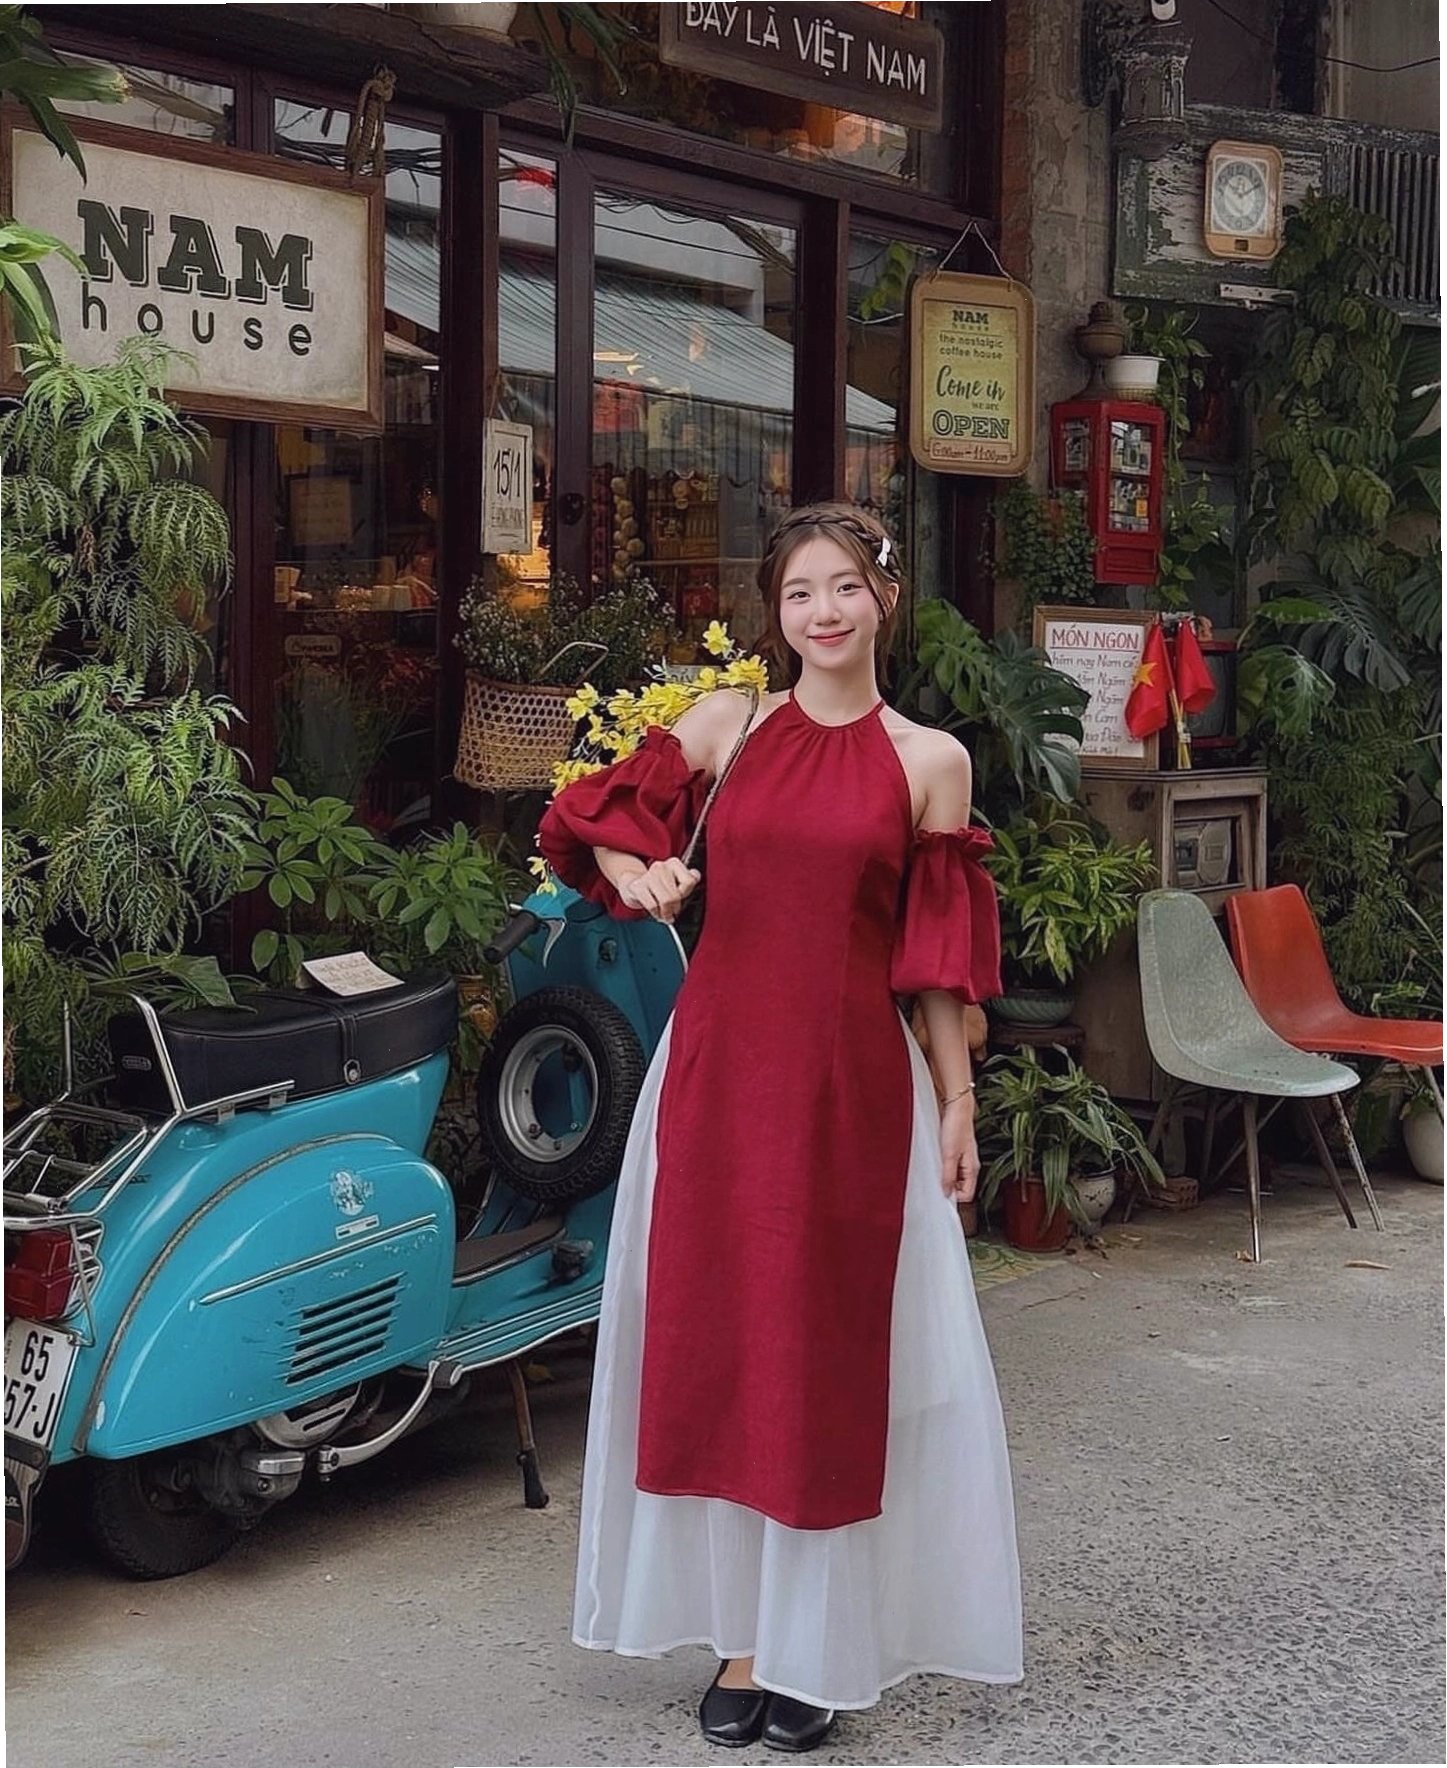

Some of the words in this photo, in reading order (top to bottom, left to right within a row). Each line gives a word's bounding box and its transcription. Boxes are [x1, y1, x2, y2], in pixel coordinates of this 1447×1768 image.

[746, 6, 780, 50] LÀ
[793, 17, 854, 77] VIỆT
[866, 40, 926, 95] NAM
[78, 199, 314, 312] NAM
[82, 281, 312, 356] house
[952, 309, 989, 325] NAM
[939, 333, 956, 344] the
[939, 346, 970, 356] coffee
[973, 349, 1003, 360] house
[936, 365, 983, 399] Come
[986, 379, 1006, 401] in
[932, 409, 1010, 440] OPEN
[493, 447, 522, 501] 15/1
[1052, 624, 1090, 647] MÓN
[1094, 631, 1140, 649] NGON
[21, 1330, 54, 1382] 65
